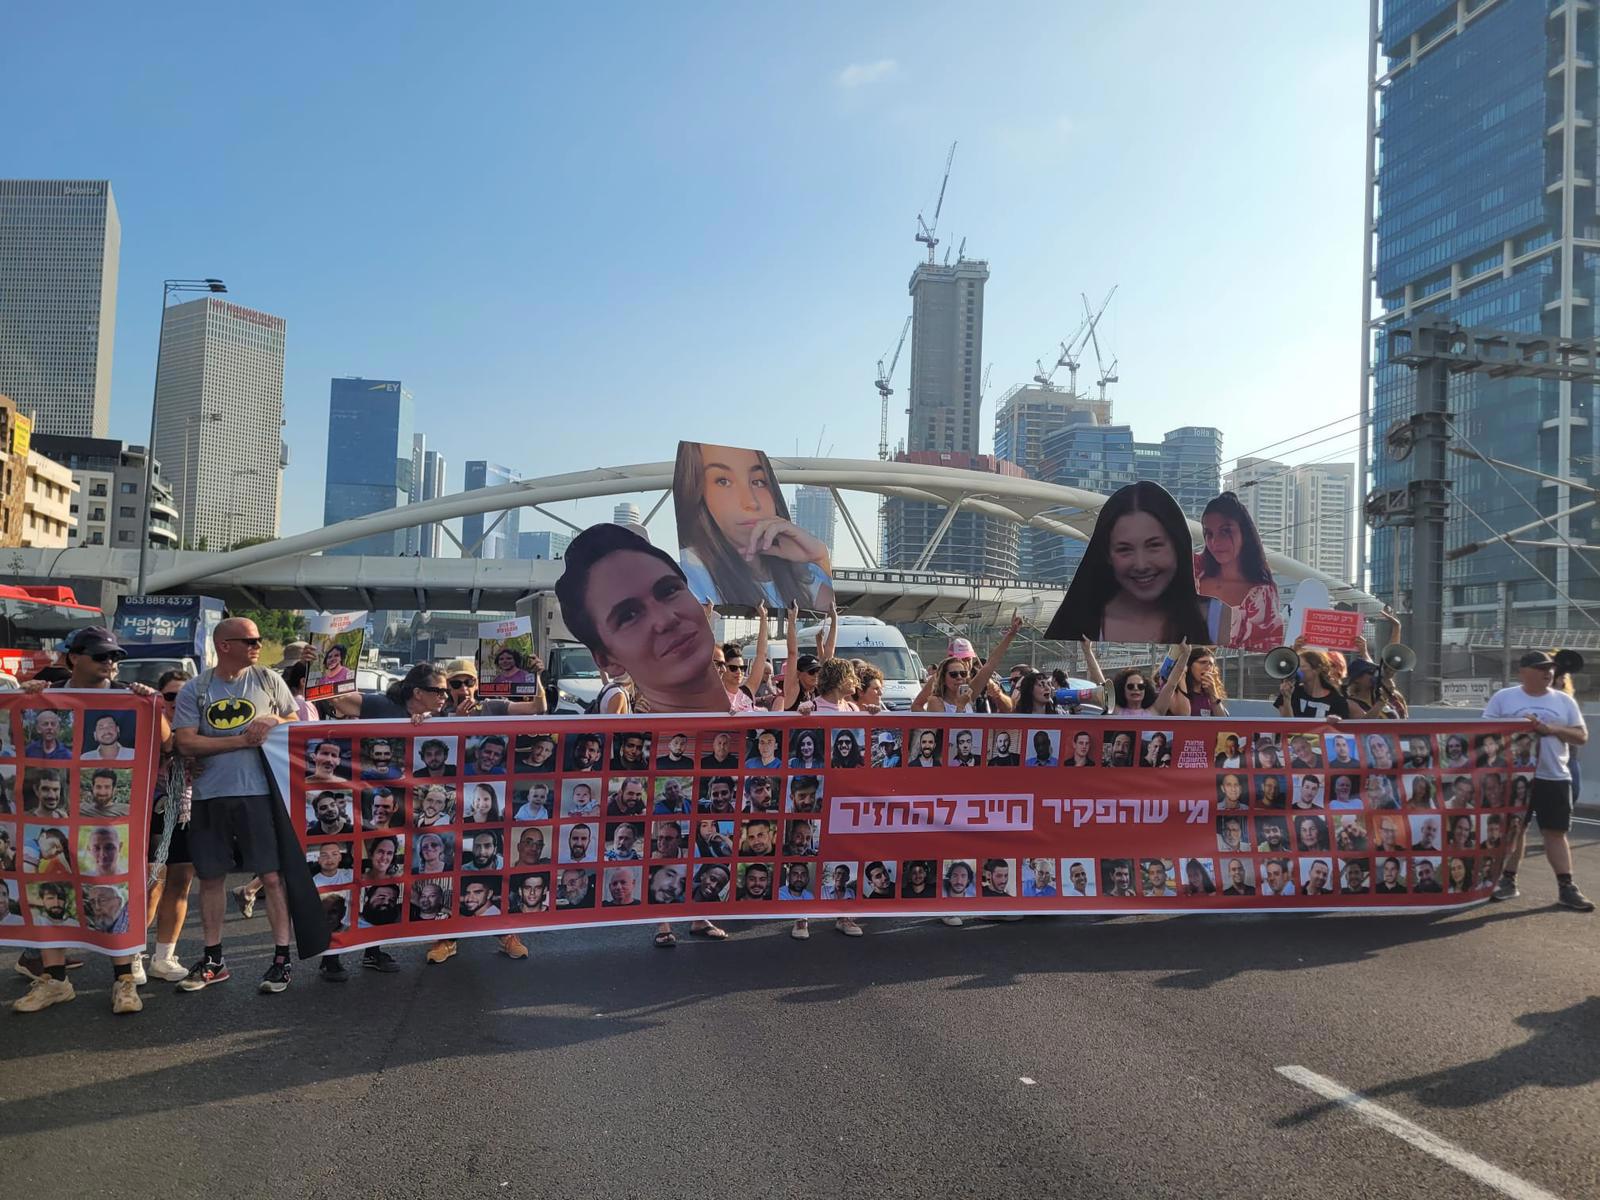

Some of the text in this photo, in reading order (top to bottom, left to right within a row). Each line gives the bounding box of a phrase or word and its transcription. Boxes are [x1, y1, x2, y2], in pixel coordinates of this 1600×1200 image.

[65, 186, 101, 195] Deloitte
[386, 383, 399, 392] EY
[1194, 428, 1210, 438] ToHa
[125, 596, 145, 605] 053
[146, 596, 166, 605] 888
[167, 597, 180, 605] 43
[123, 616, 189, 628] HaMovil
[135, 626, 176, 636] Shell
[839, 797, 1210, 828] מי שהפקיר חייב להחזיר
